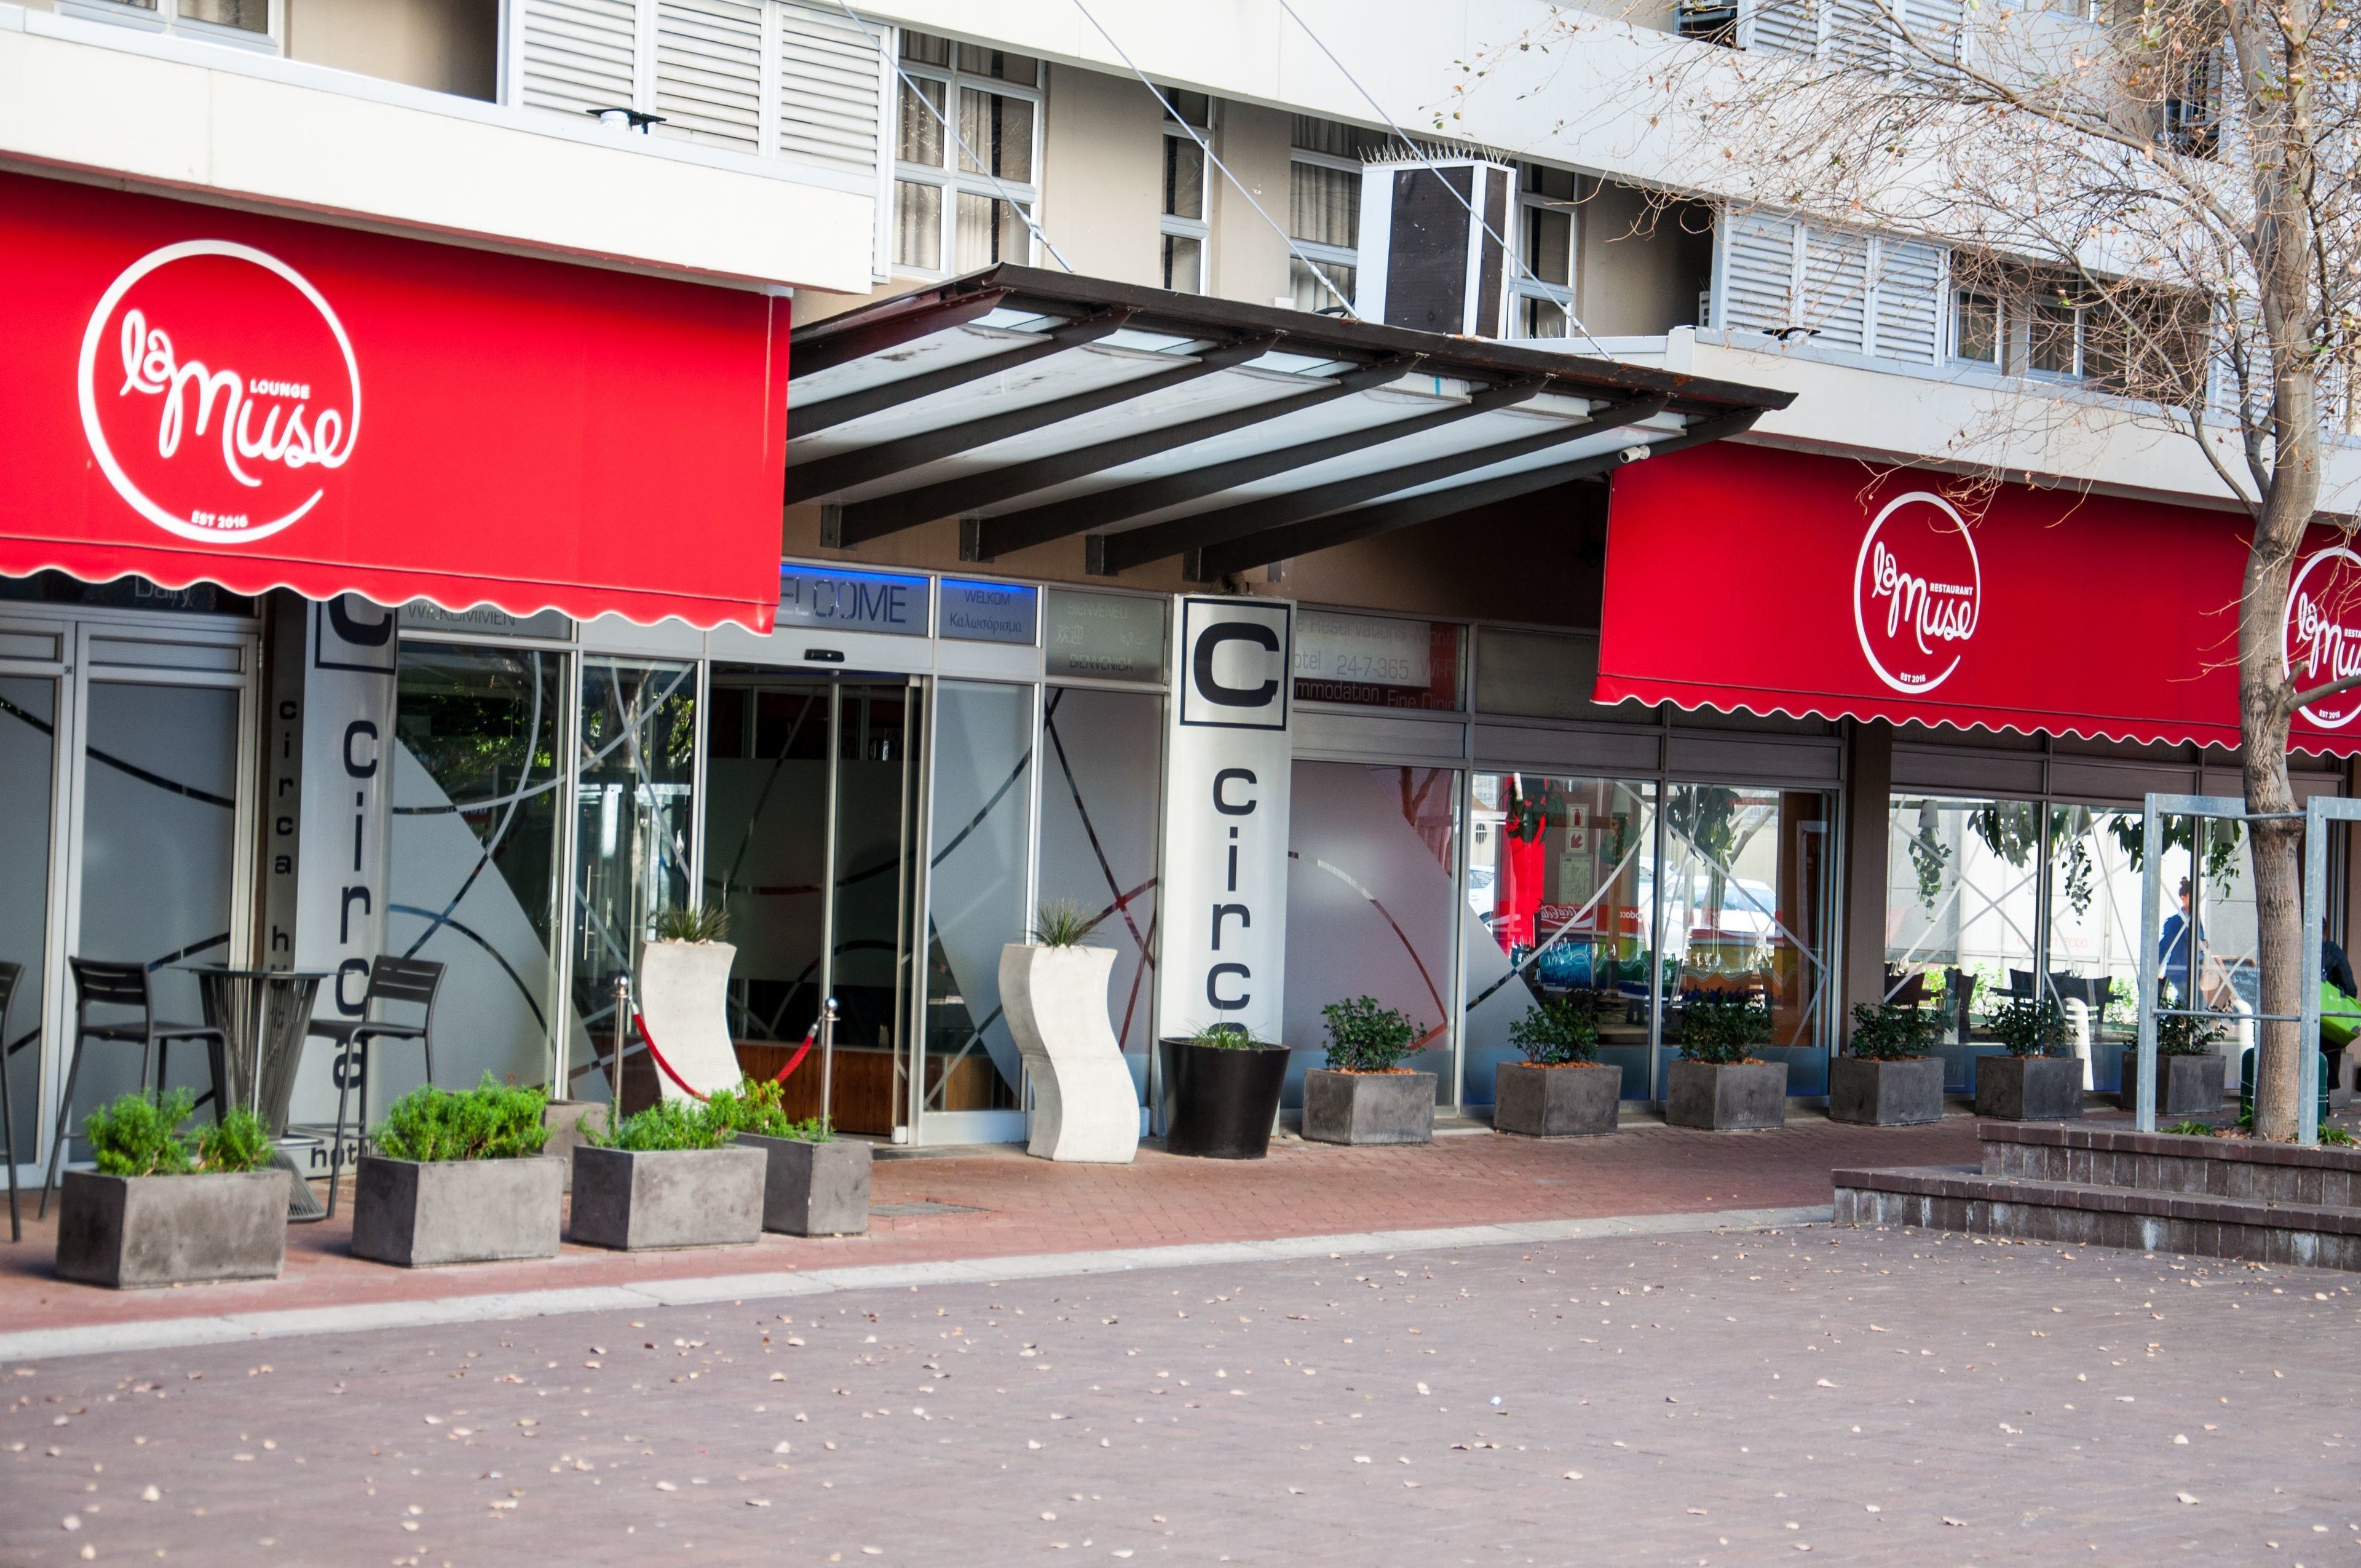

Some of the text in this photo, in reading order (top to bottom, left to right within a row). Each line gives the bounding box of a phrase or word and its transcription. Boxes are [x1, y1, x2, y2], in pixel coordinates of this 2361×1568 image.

[250, 379, 310, 400] LOUNGE
[191, 510, 248, 529] EST 2016
[965, 590, 1011, 606] WELKOM
[1930, 583, 1973, 596] RESTAURANT
[1056, 624, 1083, 645] 欢迎
[1069, 654, 1133, 672] BIENVENIDA
[1193, 622, 1280, 708] C
[1337, 655, 1409, 680] 24-7-365
[1900, 672, 1926, 683] EST 2016
[1388, 689, 1417, 708] Fine
[2319, 710, 2328, 719] EST
[274, 700, 298, 875] circa
